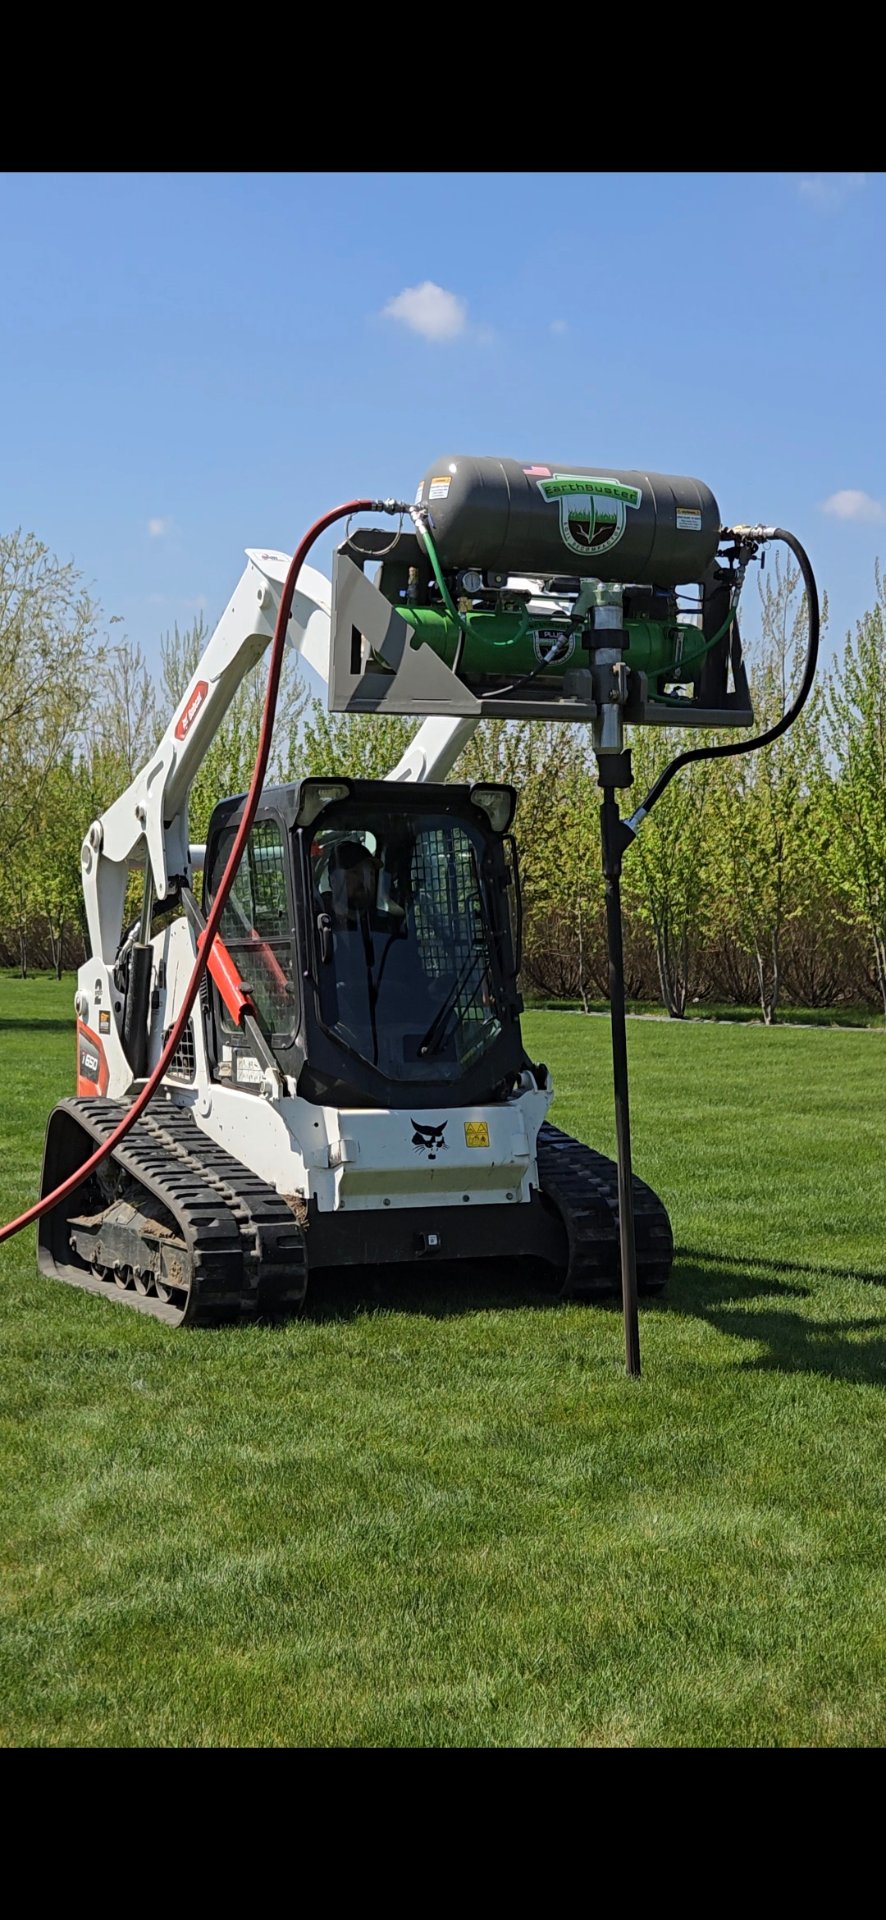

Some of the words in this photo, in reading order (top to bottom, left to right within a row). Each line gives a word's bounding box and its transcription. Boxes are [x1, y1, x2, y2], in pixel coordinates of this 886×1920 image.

[544, 483, 638, 500] EarthBuster
[563, 521, 572, 540] SOIL
[572, 526, 621, 552] DECOMPACTOR
